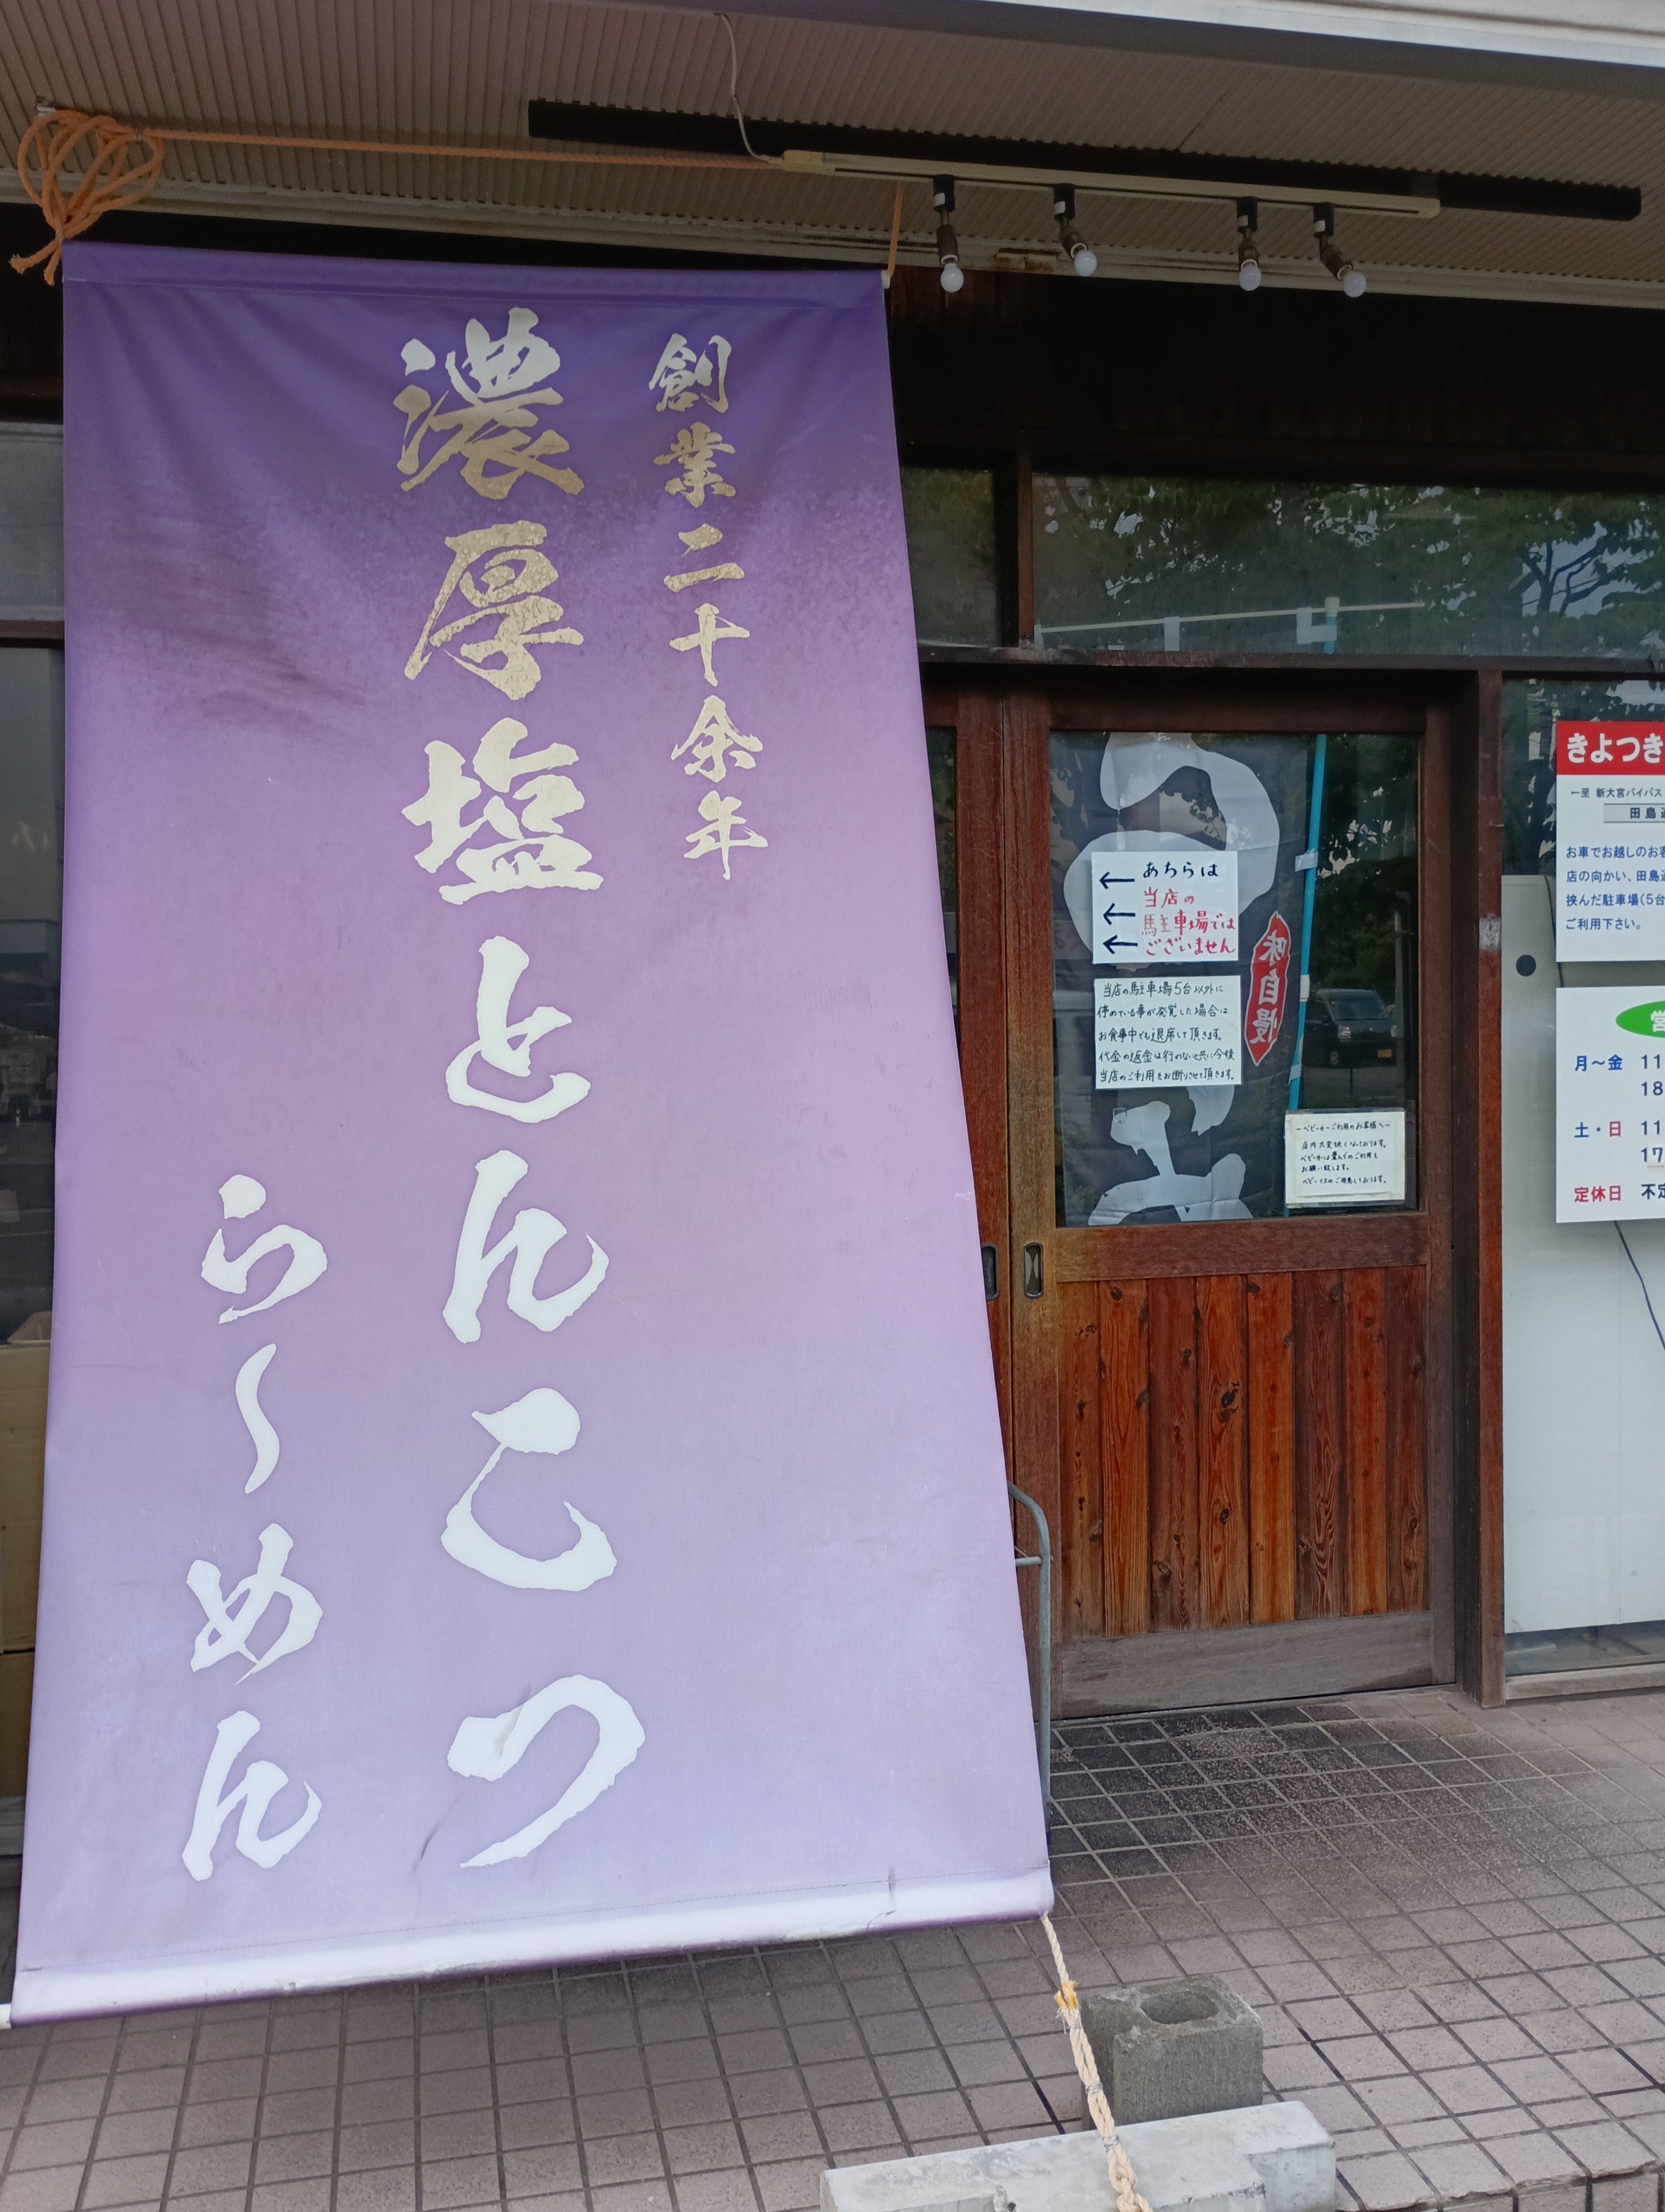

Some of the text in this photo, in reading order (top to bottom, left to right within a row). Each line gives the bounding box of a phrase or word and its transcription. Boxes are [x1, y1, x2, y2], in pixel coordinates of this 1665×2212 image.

[649, 333, 768, 879] 創業二十余年
[1567, 732, 1663, 763] きよつき
[1596, 787, 1662, 798] 新大宮バイパス
[1143, 861, 1218, 878] あちらは
[1144, 886, 1194, 908] 当店の
[1566, 917, 1641, 930] ご利用下さい。
[1146, 936, 1235, 956] ございません
[1640, 1054, 1660, 1069] 11
[393, 307, 646, 1867] 濃厚塩とんこつ
[1640, 1081, 1663, 1096] 18
[1640, 1120, 1660, 1135] 11
[1640, 1147, 1663, 1163] 17
[1574, 1185, 1621, 1202] 定休日
